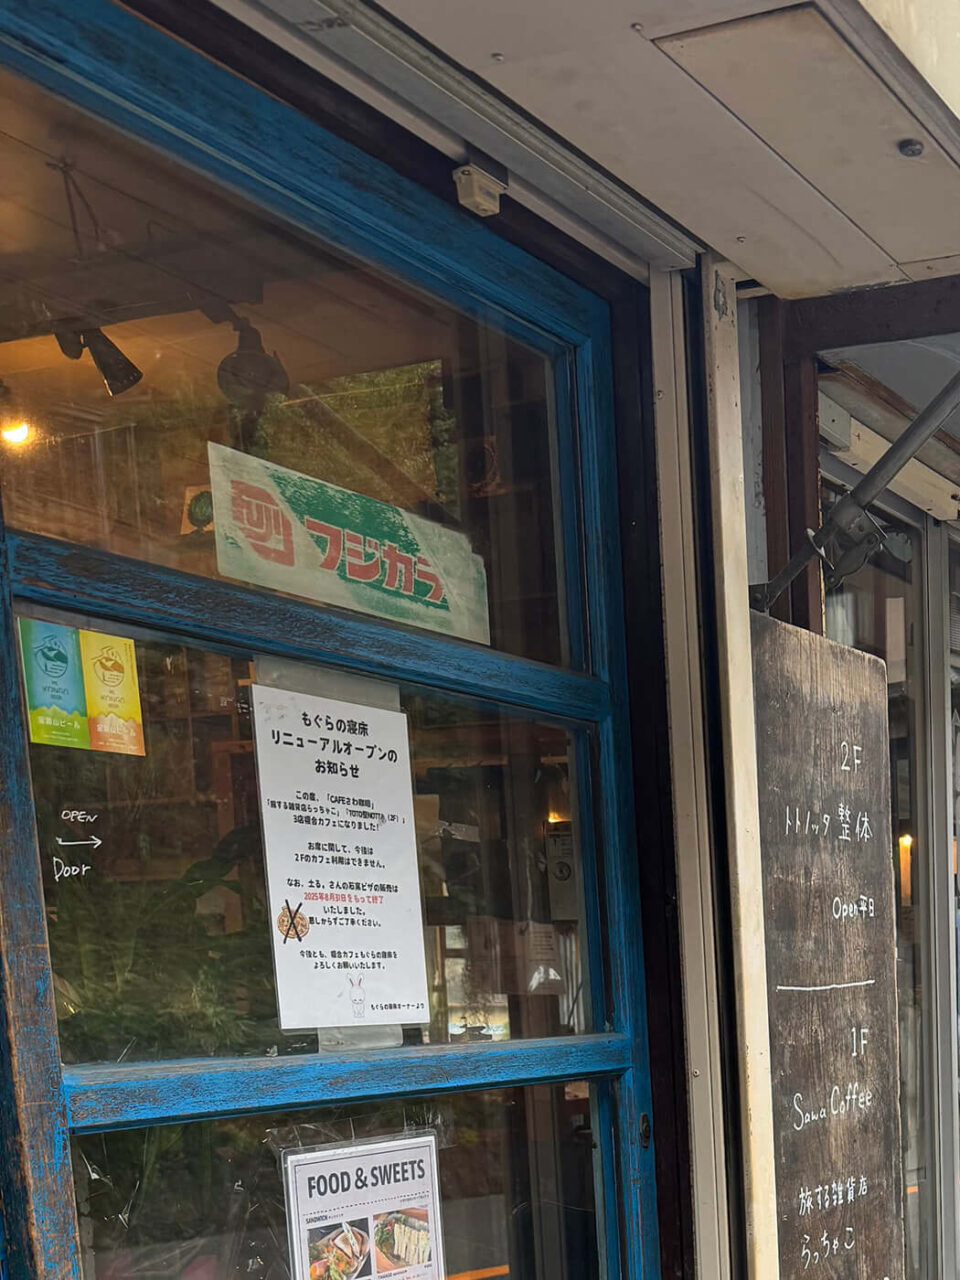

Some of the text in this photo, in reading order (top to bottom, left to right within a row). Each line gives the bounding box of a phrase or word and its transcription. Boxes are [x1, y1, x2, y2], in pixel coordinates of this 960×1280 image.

[302, 711, 369, 737] もぐらの寝床
[271, 729, 398, 763] リニューアルオープンの
[841, 741, 862, 773] 2F
[315, 759, 360, 778] お知らせ
[61, 809, 98, 822] OPEN
[53, 856, 91, 882] Door
[851, 1027, 869, 1057] 1F
[793, 1082, 872, 1130] Sawa Coffee
[307, 1171, 350, 1198] FOOD
[371, 1159, 425, 1187] SWEETS
[799, 1175, 868, 1216] 旅する雑貨店
[801, 1227, 855, 1269] らっちゃこ
